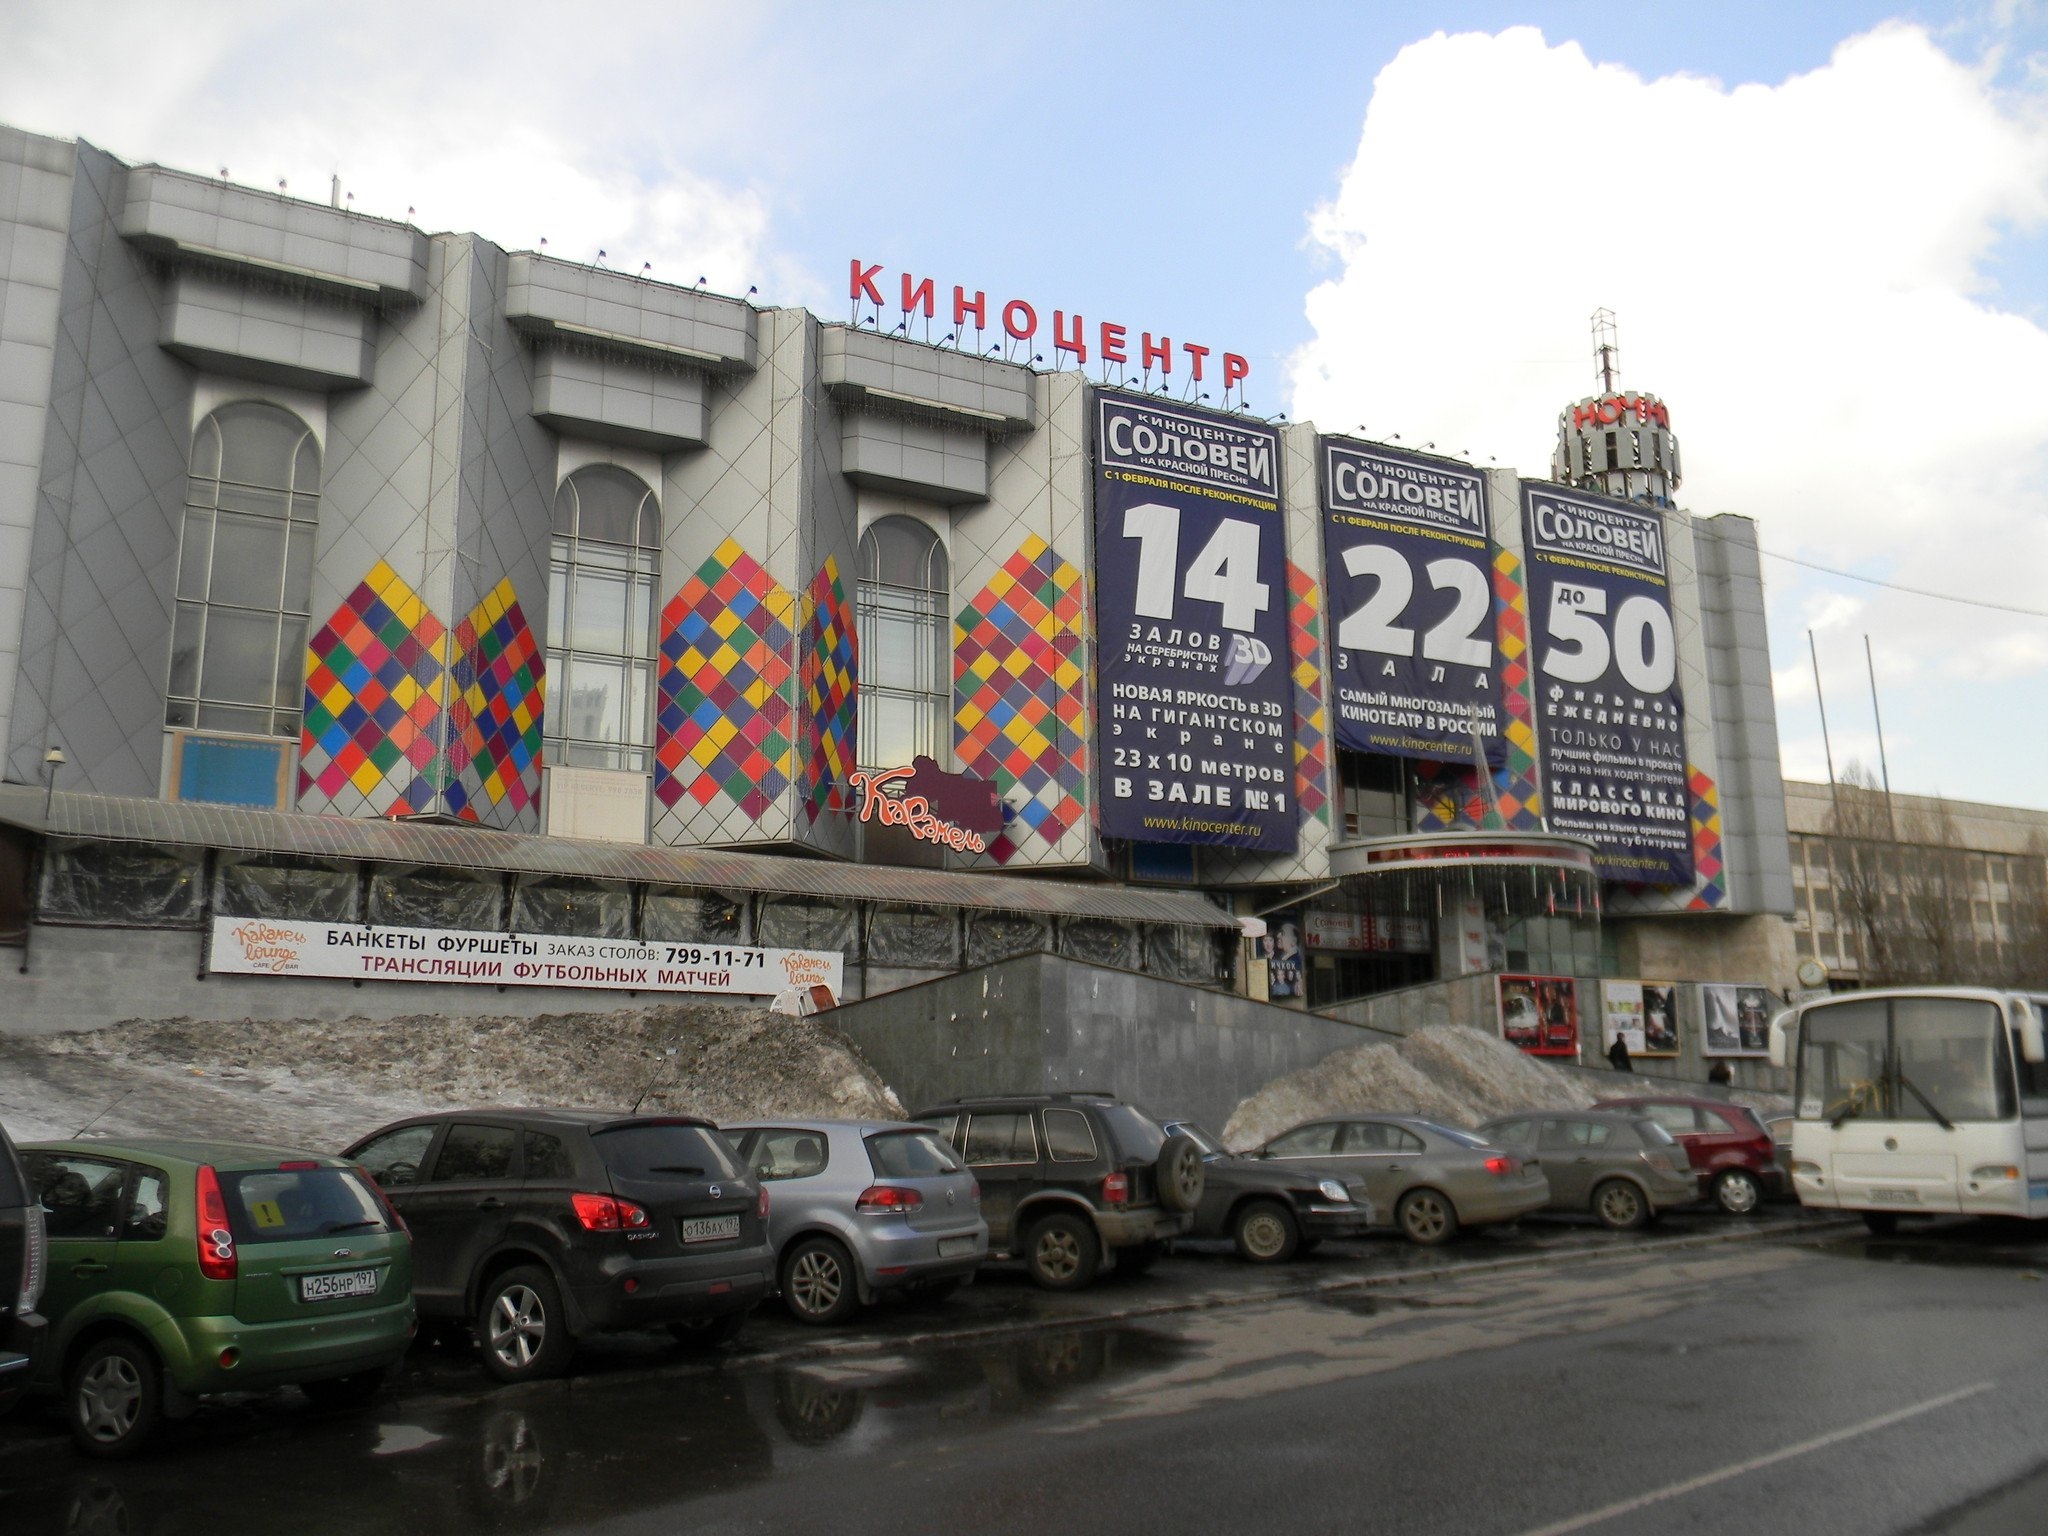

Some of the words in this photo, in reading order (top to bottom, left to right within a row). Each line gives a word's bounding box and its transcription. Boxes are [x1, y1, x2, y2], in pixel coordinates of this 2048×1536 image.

[850, 259, 1250, 389] КИНОЦЕНТР
[1573, 394, 1671, 432] НОЧН
[1138, 413, 1246, 443] КИНОЦЕНТР
[1108, 415, 1271, 487] СОЛОВЕЙ
[1141, 457, 1156, 466] НА
[1158, 458, 1209, 477] КРАСНОЙ
[1210, 468, 1248, 486] ПРЕСНЕ
[1361, 460, 1457, 486] КИНОЦЕНТР
[1105, 470, 1112, 480] С
[1114, 471, 1120, 481] 1
[1122, 472, 1168, 488] ФЕВРАЛЯ
[1170, 481, 1202, 495] ПОСЛЕ
[1203, 489, 1277, 512] РЕКОНСТРУКЦИИ
[1336, 461, 1479, 526] СОЛОВЕЙ
[1363, 501, 1377, 510] НА
[1378, 502, 1425, 518] КРАСНОЙ
[1426, 511, 1460, 526] ПРЕСНЕ
[1557, 503, 1639, 529] КИНОЦЕНТР
[1332, 514, 1340, 523] С
[1341, 515, 1346, 525] 1
[1347, 515, 1389, 531] ФЕВРАЛЯ
[1390, 524, 1419, 536] ПОСЛЕ
[1420, 529, 1486, 550] РЕКОНСТРУКЦИИ
[1536, 505, 1660, 566] СОЛОВЕЙ
[1562, 541, 1574, 549] НА
[1575, 541, 1614, 557] КРАСНОЙ
[1123, 503, 1270, 633] 14
[1536, 553, 1543, 562] С
[1544, 554, 1548, 563] 1
[1549, 555, 1586, 570] ФЕВРАЛЯ
[1586, 562, 1611, 575] ПОСЛЕ
[1611, 566, 1666, 587] РЕКОНСТРУКЦИИ
[1338, 544, 1493, 668] 22
[1558, 588, 1586, 605] ДО
[1129, 623, 1221, 650] ЗАЛОВ
[1232, 633, 1273, 666] 3D
[1542, 581, 1676, 694] 50
[1124, 653, 1217, 673] экранах
[1127, 643, 1142, 653] НА
[1144, 644, 1219, 664] СЕРЕБРИСТЫХ
[1337, 653, 1489, 689] ЗАЛА
[1113, 683, 1172, 702] НОВАЯ
[1177, 690, 1247, 712] ЯРКОСТЬ
[1250, 702, 1259, 714] в
[1262, 702, 1282, 717] 3D
[1340, 688, 1388, 707] САМЫЙ
[1549, 684, 1677, 716] фильмов
[1113, 704, 1141, 720] НА
[1152, 708, 1283, 737] ГИГАНТСКОМ
[1341, 704, 1423, 728] КИНОТЕАТР
[1426, 716, 1436, 730] В
[1439, 718, 1498, 737] РОССИИ
[1547, 704, 1678, 732] ЕЖЕДНЕВНО
[1113, 723, 1284, 754] экране
[1370, 734, 1472, 755] www.kinocenter.ru
[1550, 728, 1622, 750] ТОЛЬКО
[1633, 738, 1641, 752] У
[1651, 741, 1682, 759] НАС
[1114, 748, 1141, 767] 23
[1167, 753, 1192, 772] 10
[1201, 760, 1285, 783] метров
[1551, 748, 1591, 760] лучшие
[1592, 751, 1636, 765] фильмы
[1645, 760, 1682, 772] прокате
[1552, 762, 1576, 773] пока
[1580, 765, 1592, 775] на
[1595, 767, 1612, 778] них
[1614, 769, 1643, 782] ходят
[1114, 777, 1132, 798] В
[1148, 780, 1231, 806] ЗАЛЕ
[1552, 781, 1685, 807] КЛАССИКА
[1553, 796, 1641, 817] МИРОВОГО
[1645, 805, 1686, 821] КИНО
[1144, 816, 1262, 837] www.kinocenter.ru
[1595, 822, 1608, 831] на
[1609, 823, 1638, 833] языке
[1640, 826, 1686, 838] оригинала
[1621, 836, 1687, 850] субтитрами
[244, 943, 300, 972] lounge
[327, 930, 426, 950] БАНКЕТЫ
[437, 935, 537, 956] ФУРШЕТЫ
[548, 943, 595, 957] ЗАКАЗ
[600, 946, 660, 961] СТОЛОВ:
[665, 948, 764, 968] 799-11-71
[361, 955, 502, 979] ТРАНСЛЯЦИИ
[514, 962, 647, 983] ФУТБОЛЬНЫХ
[657, 969, 730, 987] МАТЧЕЙ
[1271, 962, 1296, 970] ИЧКОК
[306, 1276, 353, 1297] Н256НР
[355, 1272, 373, 1285] 197
